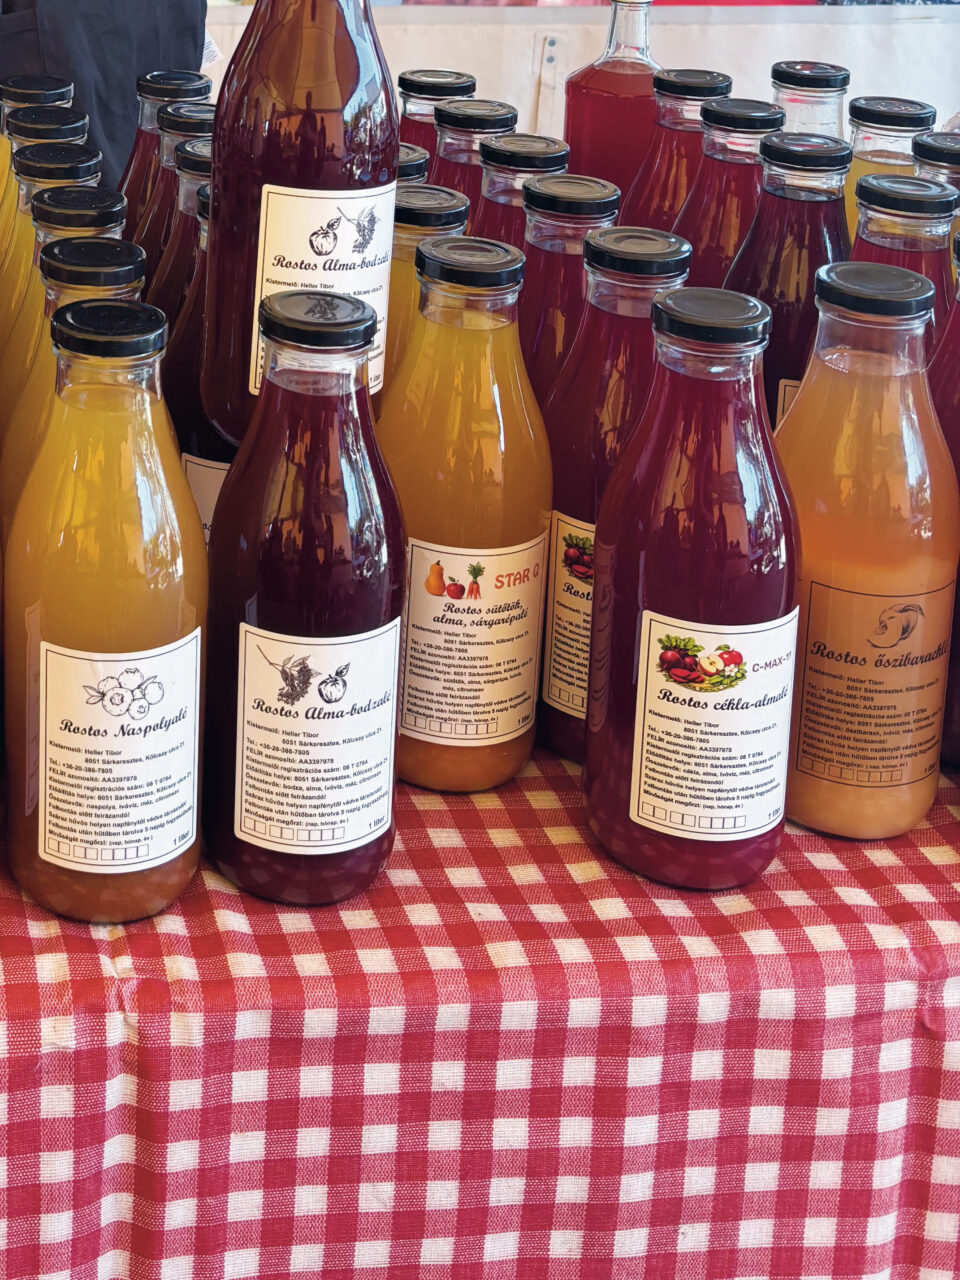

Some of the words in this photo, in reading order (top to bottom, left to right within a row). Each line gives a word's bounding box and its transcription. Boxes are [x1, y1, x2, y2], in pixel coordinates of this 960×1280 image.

[272, 254, 318, 271] Rostos
[319, 282, 335, 290] Tibor
[494, 567, 530, 590] STAR
[443, 602, 482, 616] Rostos
[486, 599, 524, 616] sütőtök,
[433, 614, 468, 628] alma,
[471, 608, 529, 630] sárgarépalé
[810, 641, 867, 667] Rostos
[252, 697, 299, 719] Rostos
[657, 688, 708, 710] Rostos
[714, 685, 789, 711] cékla-almalé
[59, 719, 108, 738] Rostos
[114, 706, 188, 738] Naspolyalé
[281, 729, 301, 737] Heller
[84, 748, 104, 756] Heller
